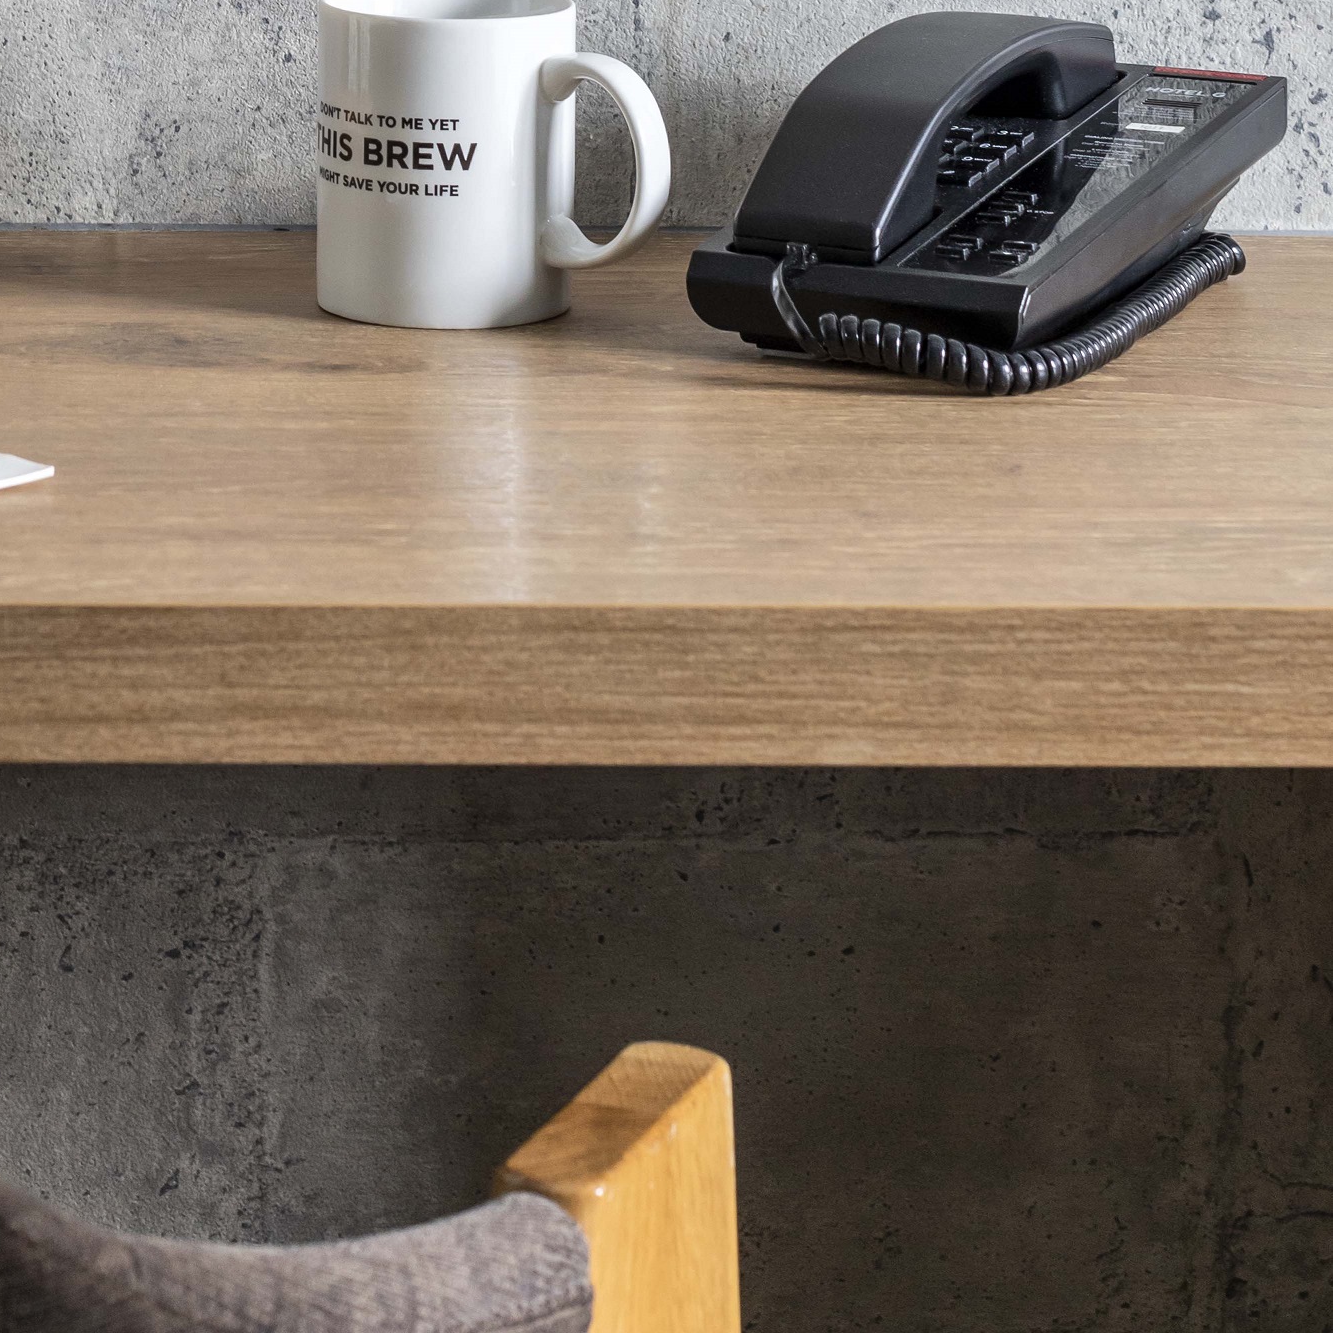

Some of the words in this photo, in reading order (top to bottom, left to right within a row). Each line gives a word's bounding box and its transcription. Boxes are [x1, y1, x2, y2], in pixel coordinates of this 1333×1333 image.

[1144, 85, 1204, 98] HOTEL
[343, 109, 373, 126] TALK
[377, 115, 397, 128] TO
[402, 117, 424, 130] ME
[428, 118, 460, 131] YET
[363, 137, 478, 171] BREW
[343, 174, 373, 192] SAVE
[377, 180, 419, 196] YOUR
[424, 184, 459, 197] LIFE
